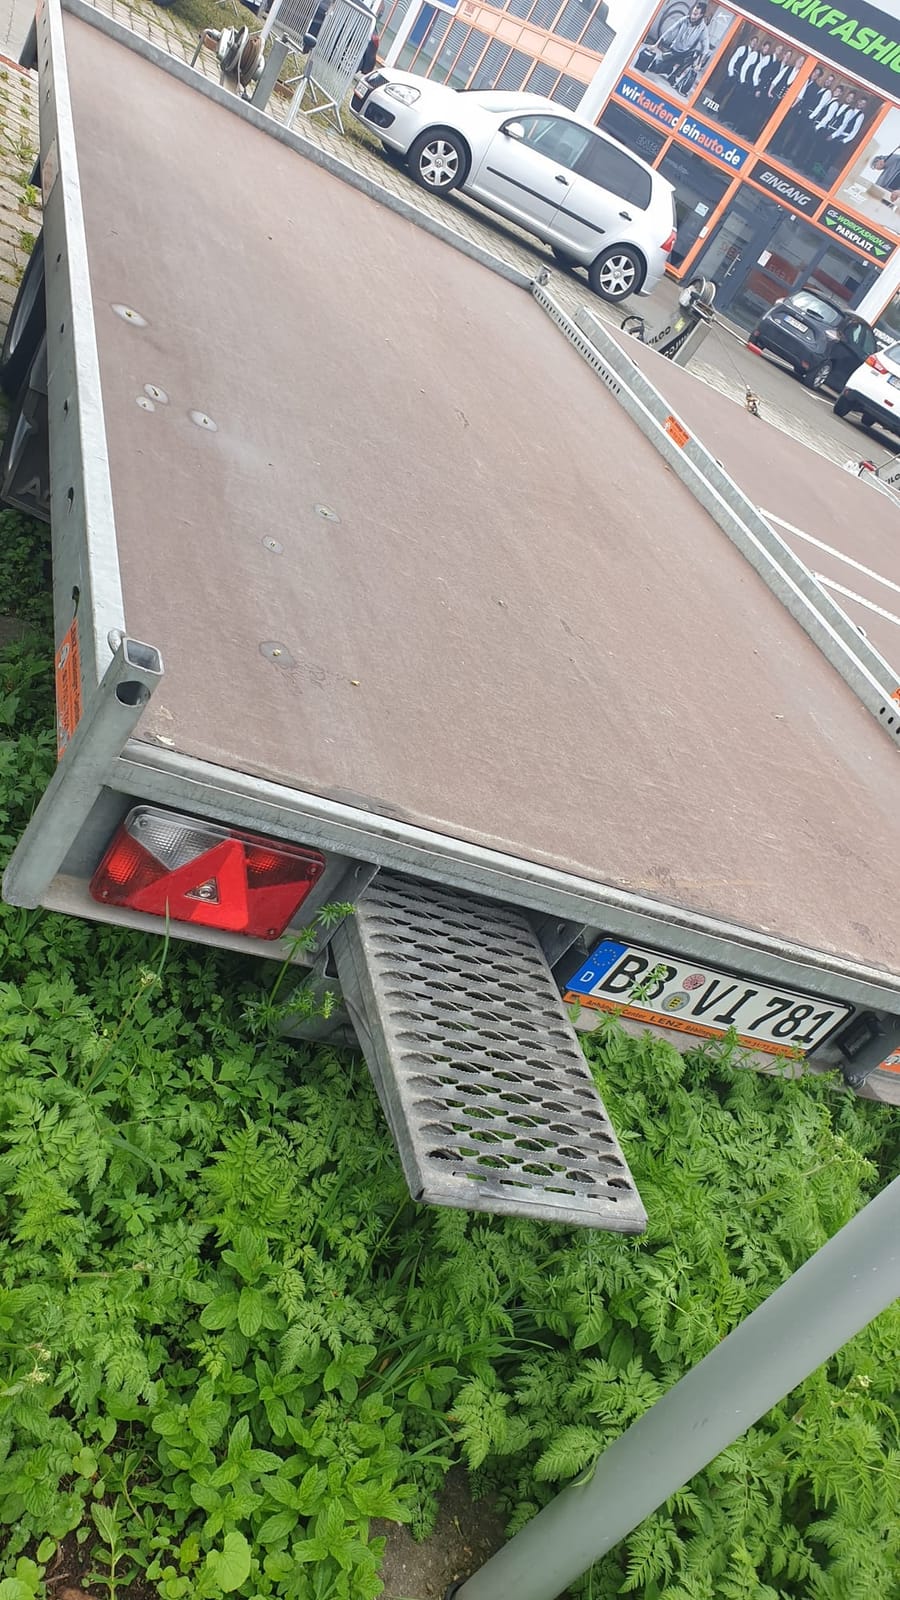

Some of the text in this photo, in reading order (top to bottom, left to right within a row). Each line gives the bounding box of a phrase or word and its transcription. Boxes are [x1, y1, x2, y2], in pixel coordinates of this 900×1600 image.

[759, 171, 811, 205] EINGANG
[835, 224, 874, 251] PARKPLATZ
[580, 971, 594, 983] D
[599, 954, 835, 1043] BB VI 781
[649, 1015, 684, 1029] LENZ
